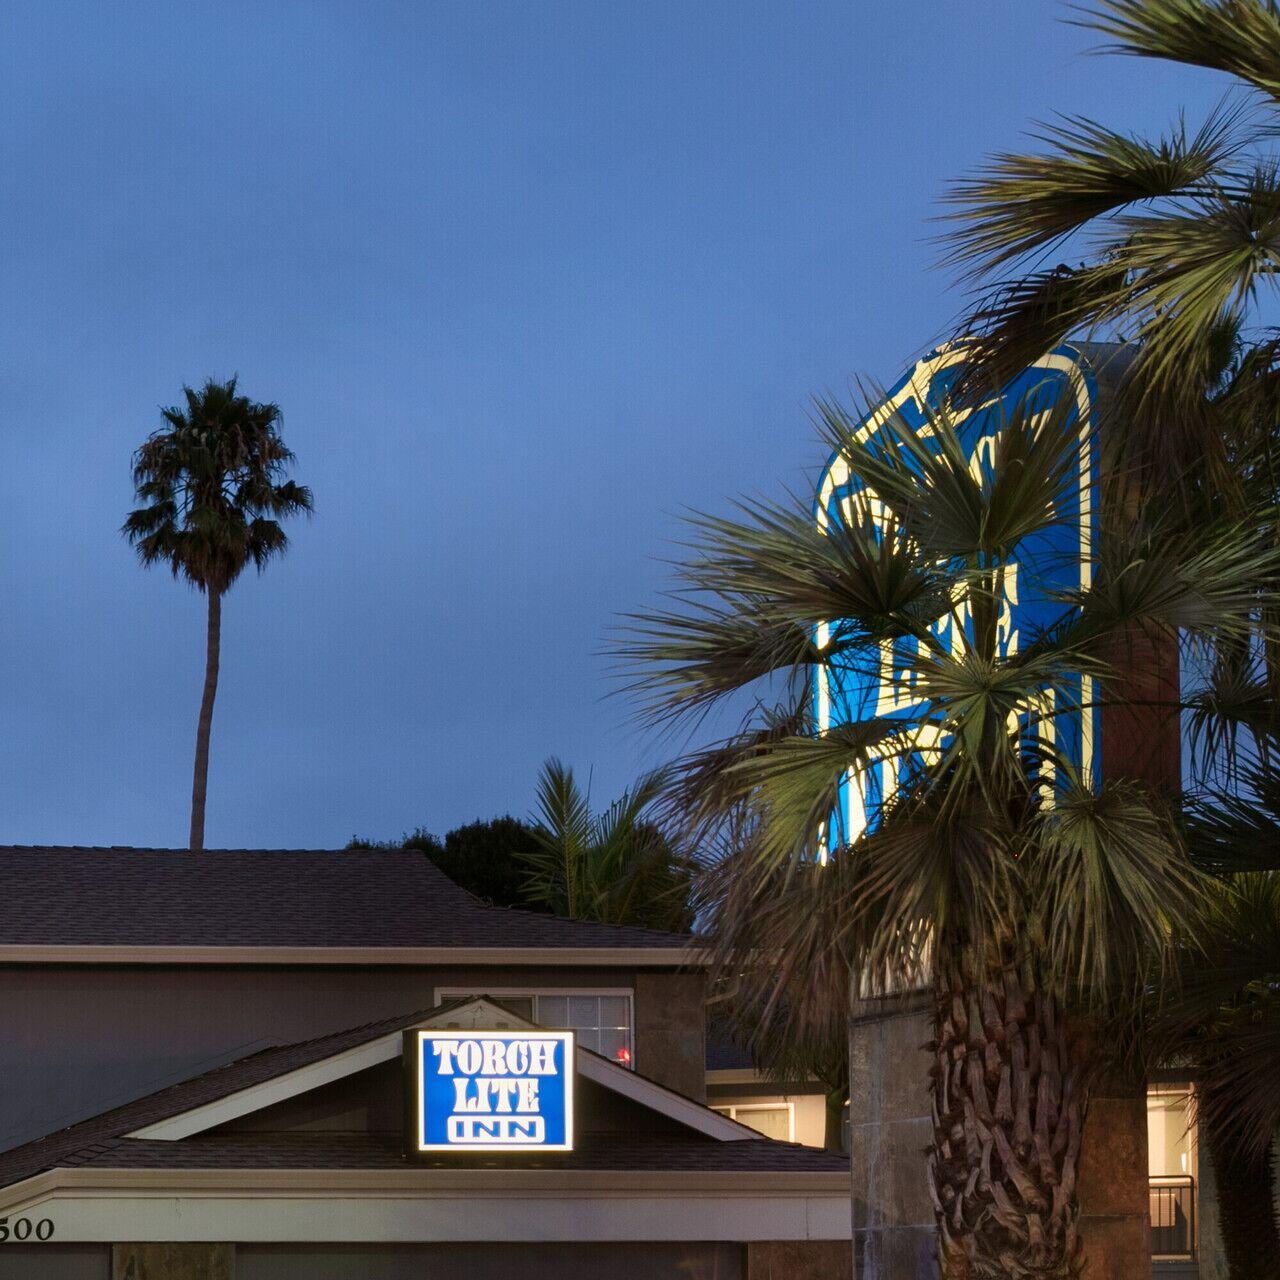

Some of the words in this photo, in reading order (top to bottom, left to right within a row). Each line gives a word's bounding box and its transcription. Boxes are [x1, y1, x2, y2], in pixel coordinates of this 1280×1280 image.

[432, 1040, 557, 1075] TORCH
[453, 1078, 540, 1112] LITE
[456, 1121, 536, 1137] INN
